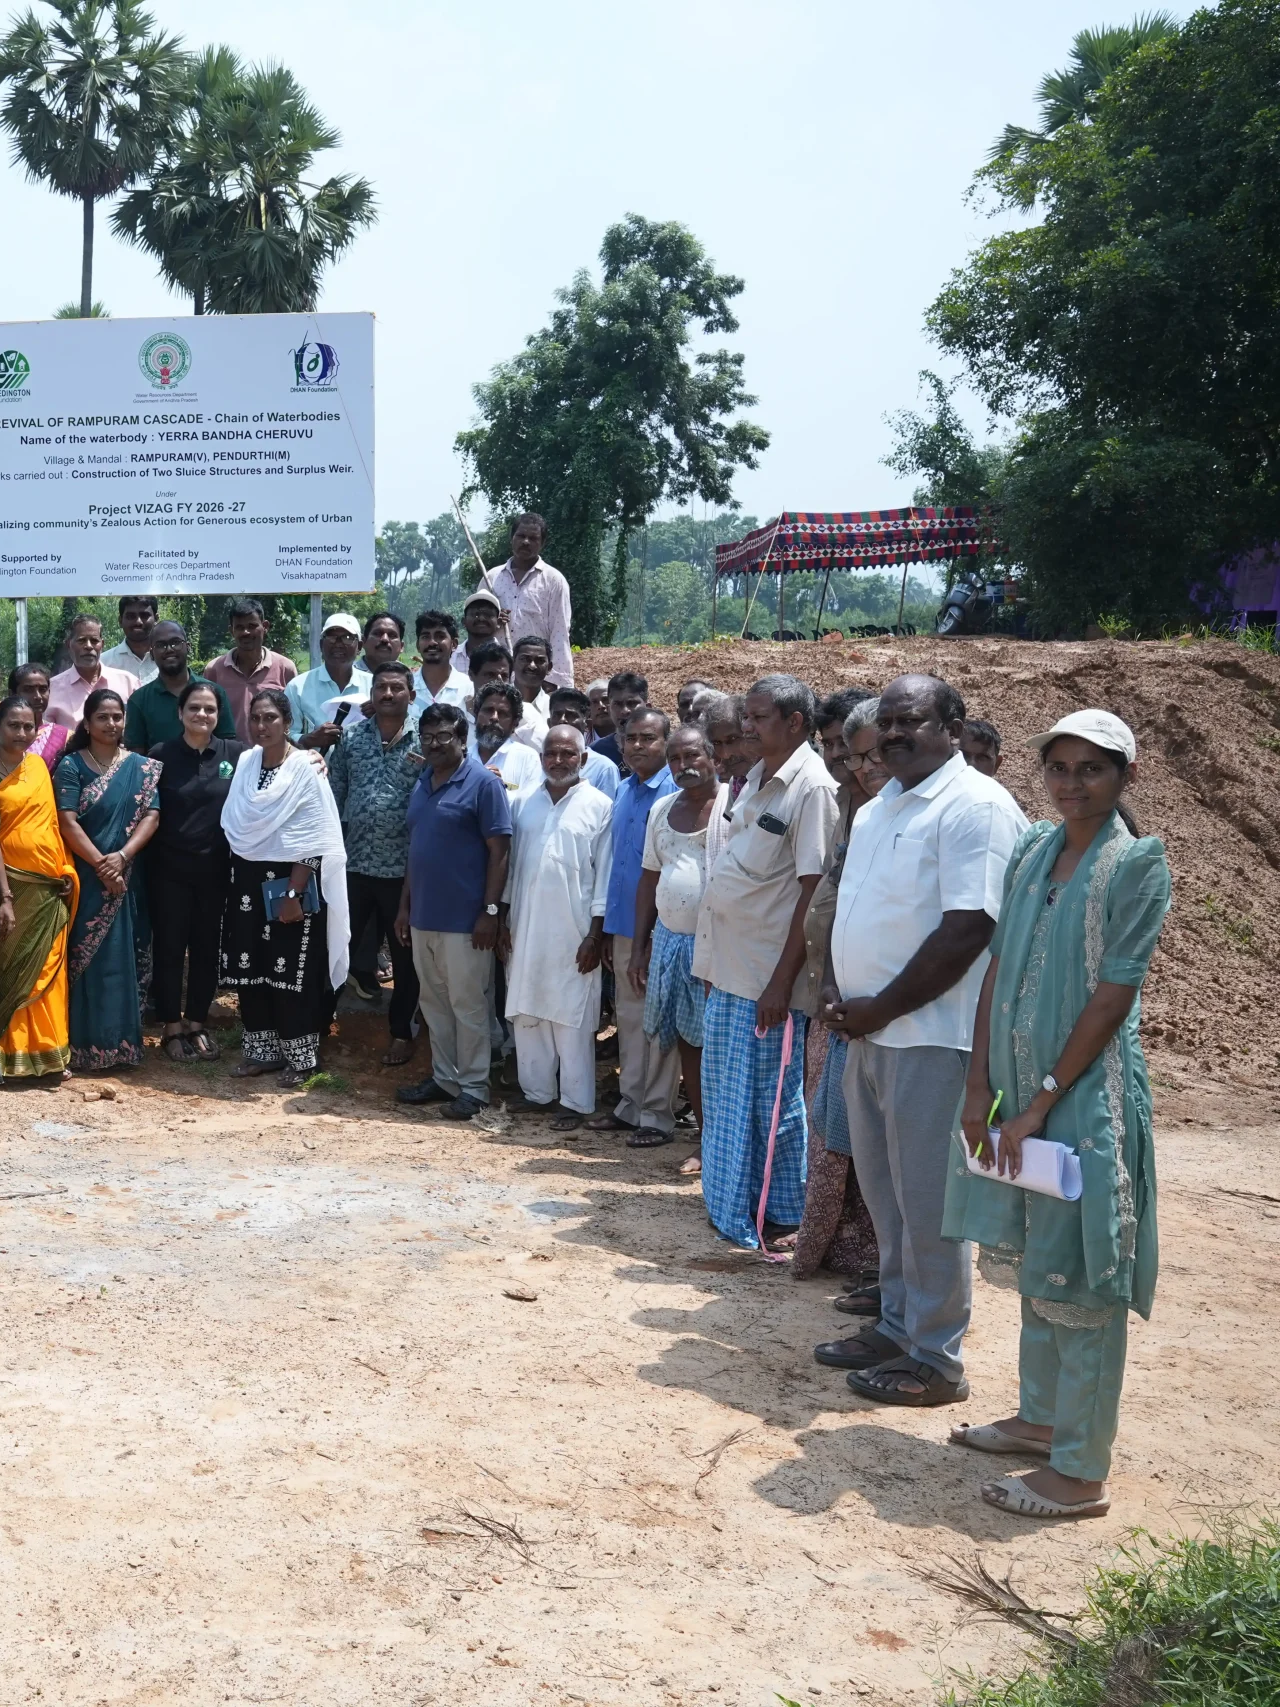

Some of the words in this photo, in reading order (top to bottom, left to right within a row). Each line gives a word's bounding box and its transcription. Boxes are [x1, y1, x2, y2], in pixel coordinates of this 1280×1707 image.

[47, 417, 64, 428] OF
[67, 414, 140, 427] RAMPURAM
[143, 413, 204, 425] CASCADE
[214, 412, 249, 424] Chain
[251, 412, 265, 423] of
[266, 411, 341, 423] Waterbodies
[20, 435, 52, 445] Name
[54, 434, 67, 445] of
[68, 434, 87, 444] the
[89, 432, 148, 445] waterbody
[157, 431, 199, 442] YERRA
[201, 430, 253, 441] BANDHA
[255, 428, 313, 440] CHERUVU
[43, 455, 75, 467] Village
[77, 454, 85, 465] &
[87, 454, 122, 464] Mandal
[130, 452, 210, 464] RAMPURAM(V),
[212, 450, 291, 462] PENDURTHI(M)
[13, 470, 46, 481] carried
[47, 470, 63, 480] out
[71, 468, 137, 480] Construction
[139, 467, 150, 478] of
[151, 467, 173, 477] Two
[175, 467, 207, 477] Sluice
[209, 466, 262, 476] Structures
[264, 465, 284, 475] and
[286, 464, 326, 476] Surplus
[328, 464, 354, 474] Weir.
[155, 490, 178, 498] Under
[88, 504, 132, 516] Project
[134, 503, 173, 513] VIZAG
[176, 502, 193, 513] FY
[196, 501, 225, 513] 2026
[227, 501, 246, 512] -27
[100, 518, 141, 528] Zealous
[143, 516, 177, 527] Action
[179, 516, 195, 526] for
[196, 515, 247, 526] Generous
[249, 515, 306, 526] ecosystem
[308, 513, 319, 524] of
[321, 513, 353, 523] Urban
[138, 549, 186, 559] Facilitated
[187, 549, 200, 560] by
[278, 543, 338, 555] Implemented
[340, 543, 352, 554] by
[1, 553, 49, 564] Supported
[50, 553, 62, 564] by
[275, 558, 303, 567] DHAN
[304, 557, 353, 567] Foundation
[29, 566, 77, 575] Foundation
[104, 562, 131, 571] Water
[132, 561, 179, 571] Resources
[180, 561, 231, 571] Department
[100, 573, 153, 583] Government
[155, 572, 165, 581] of
[166, 571, 198, 582] Andhra
[199, 571, 235, 581] Pradesh
[280, 571, 347, 581] Visakhapatnam
